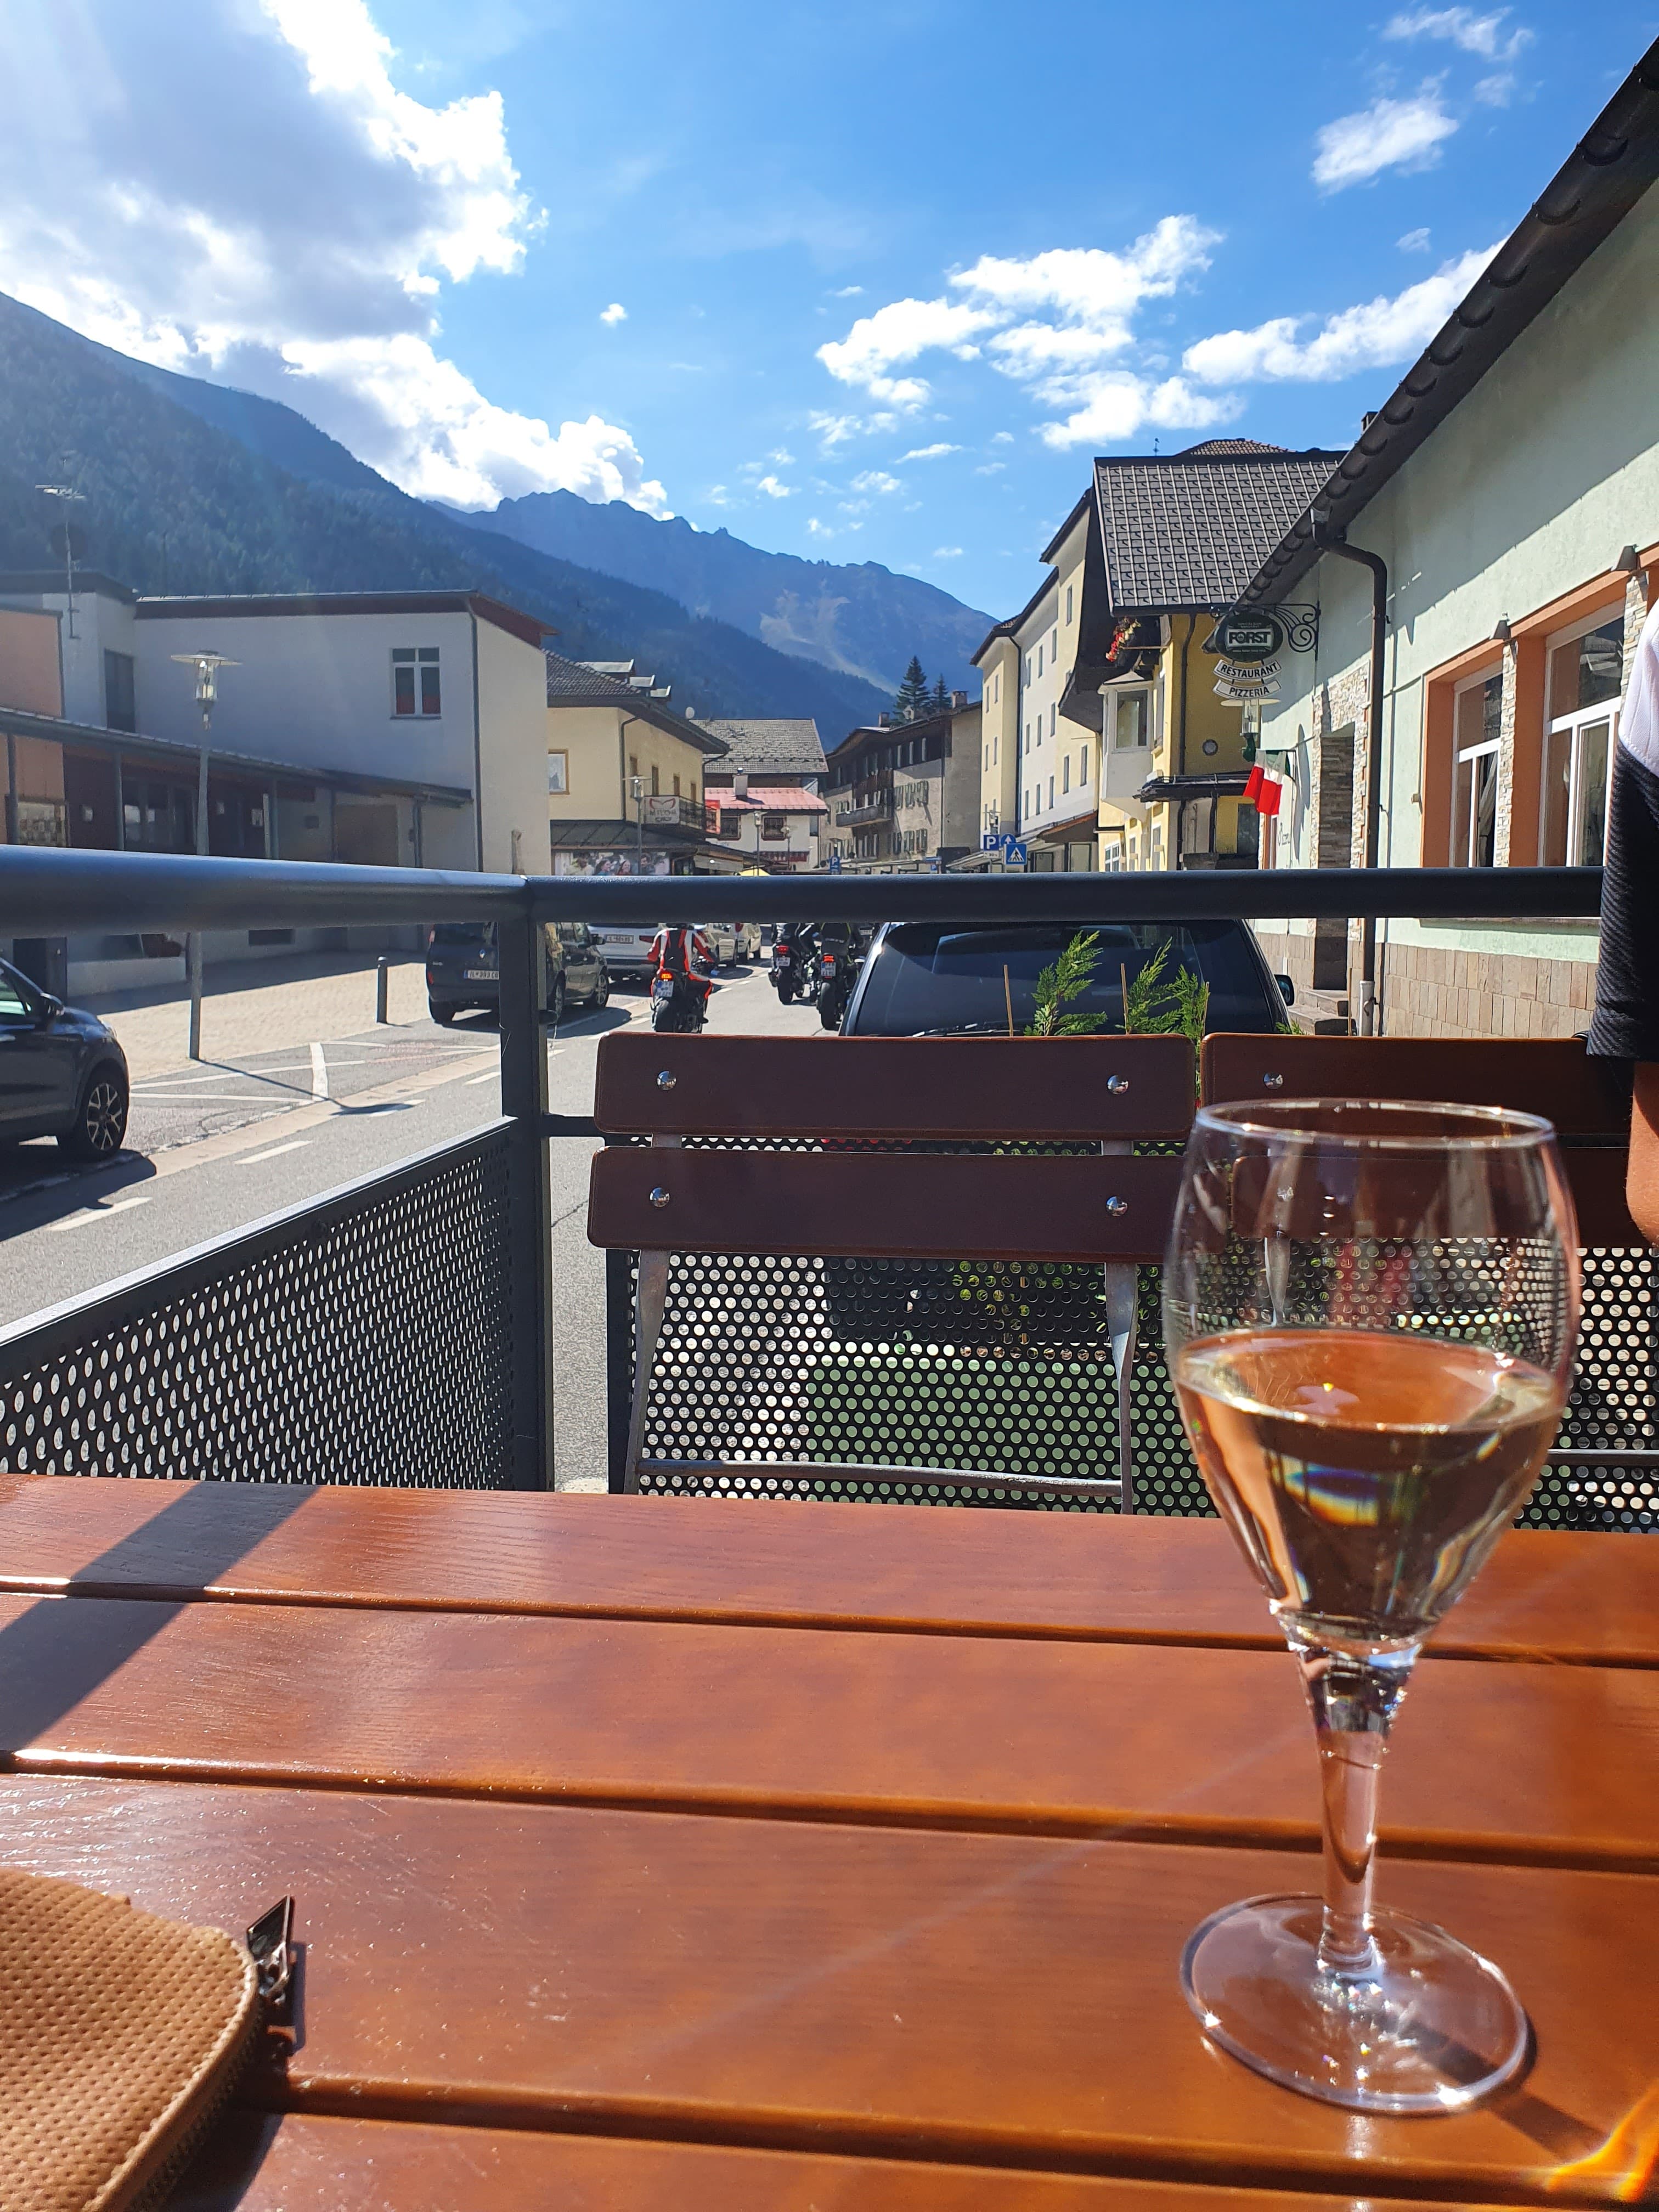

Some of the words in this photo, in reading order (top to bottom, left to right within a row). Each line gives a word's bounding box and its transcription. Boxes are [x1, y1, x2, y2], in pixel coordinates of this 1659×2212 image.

[1228, 631, 1271, 644] FORST
[1221, 662, 1278, 678] RESTAURANT
[1229, 686, 1269, 697] PIZZERIA
[986, 836, 996, 849] P
